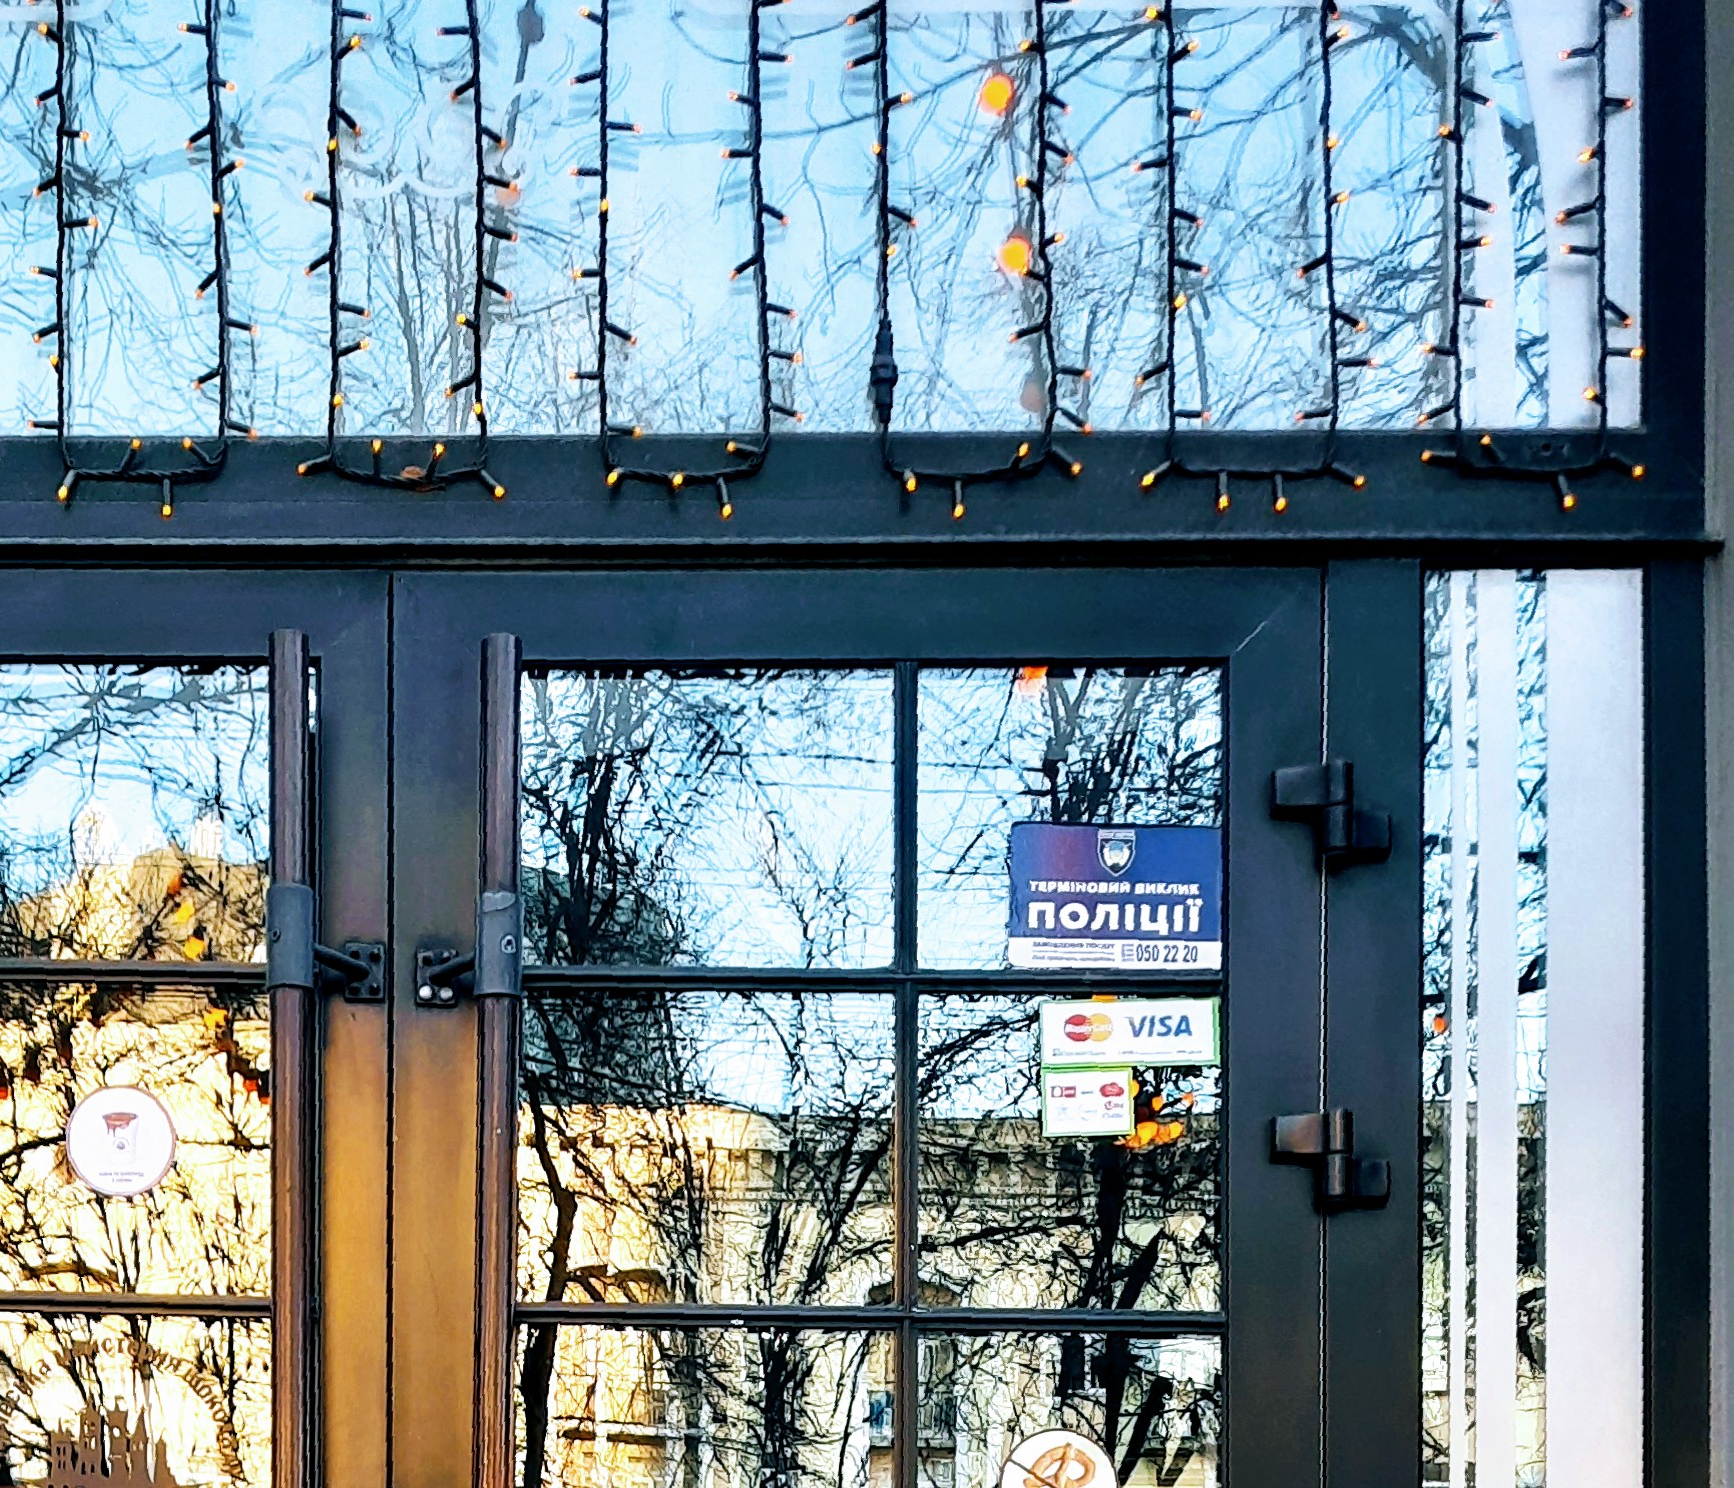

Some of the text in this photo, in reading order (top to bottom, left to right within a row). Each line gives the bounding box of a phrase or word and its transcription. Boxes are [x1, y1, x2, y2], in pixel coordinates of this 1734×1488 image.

[1029, 879, 1201, 896] ТЕРМІНОВИЙ ВИКЛИК
[1027, 898, 1204, 936] ПОЛІЦІЇ
[1162, 944, 1179, 963] 22
[1124, 1014, 1193, 1038] VISA
